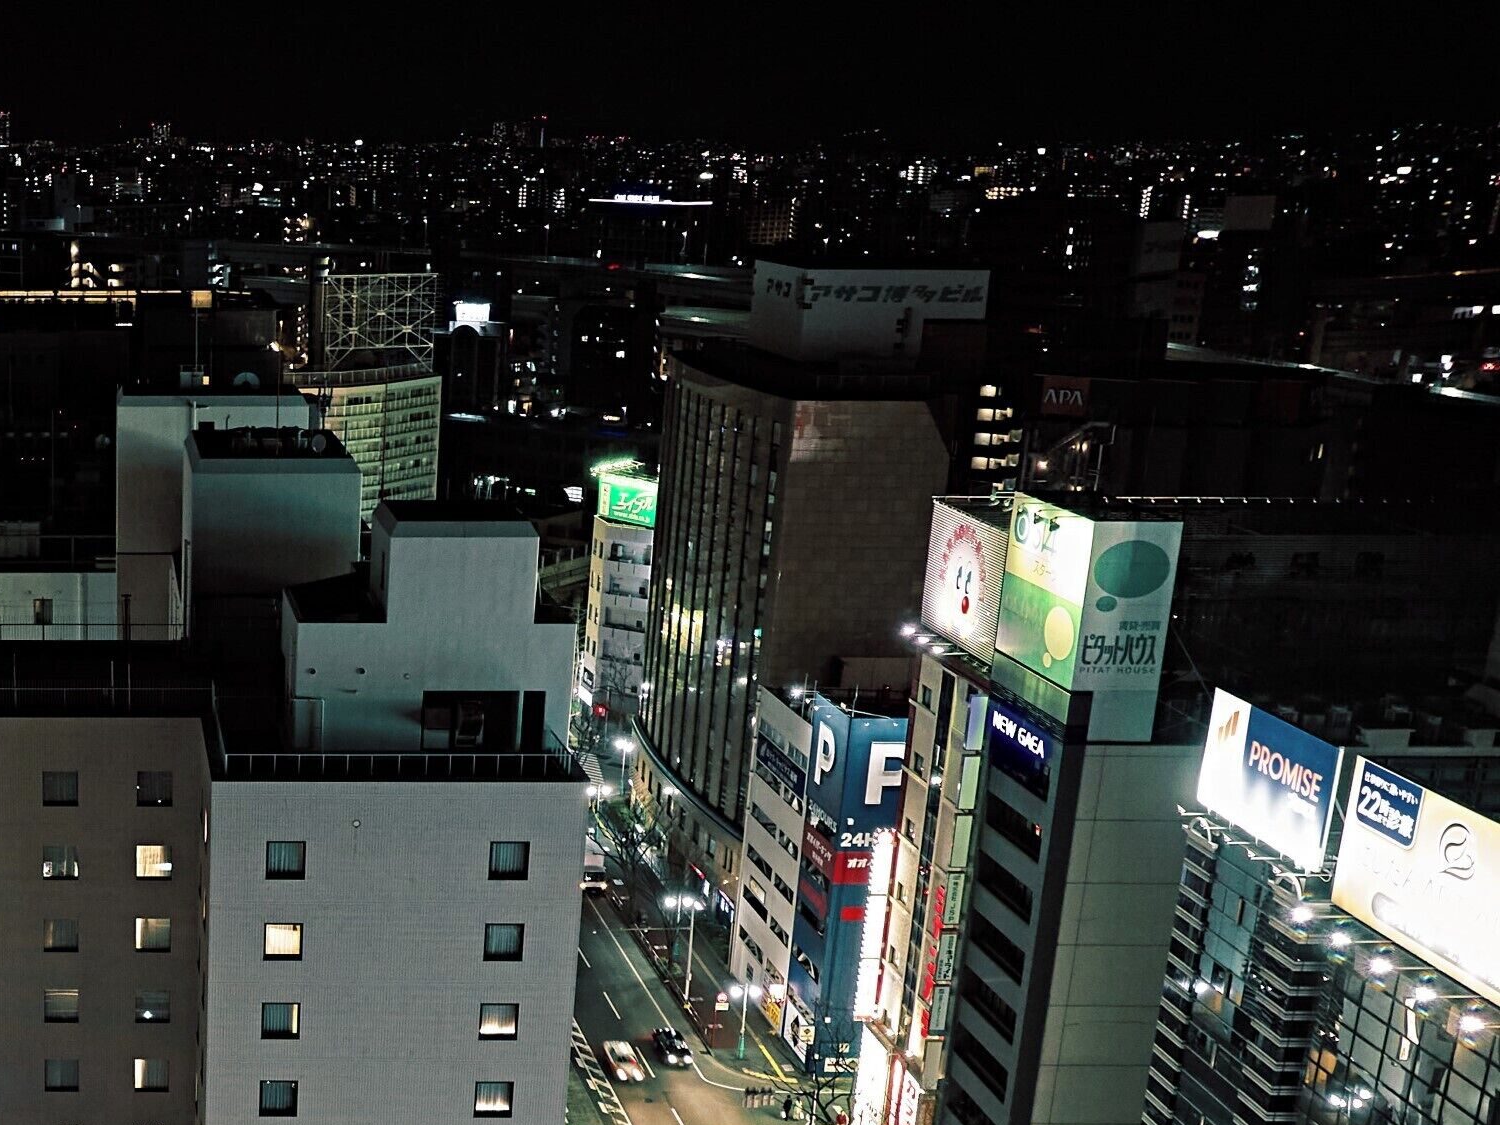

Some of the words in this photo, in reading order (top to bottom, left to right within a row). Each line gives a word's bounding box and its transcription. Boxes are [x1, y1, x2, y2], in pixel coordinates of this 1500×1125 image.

[1044, 388, 1084, 407] APA
[1081, 632, 1157, 666] ピタットハウス
[1079, 666, 1111, 675] PITAT
[992, 710, 1018, 743] NEW
[814, 721, 835, 785] P
[1248, 741, 1323, 803] PROMISE
